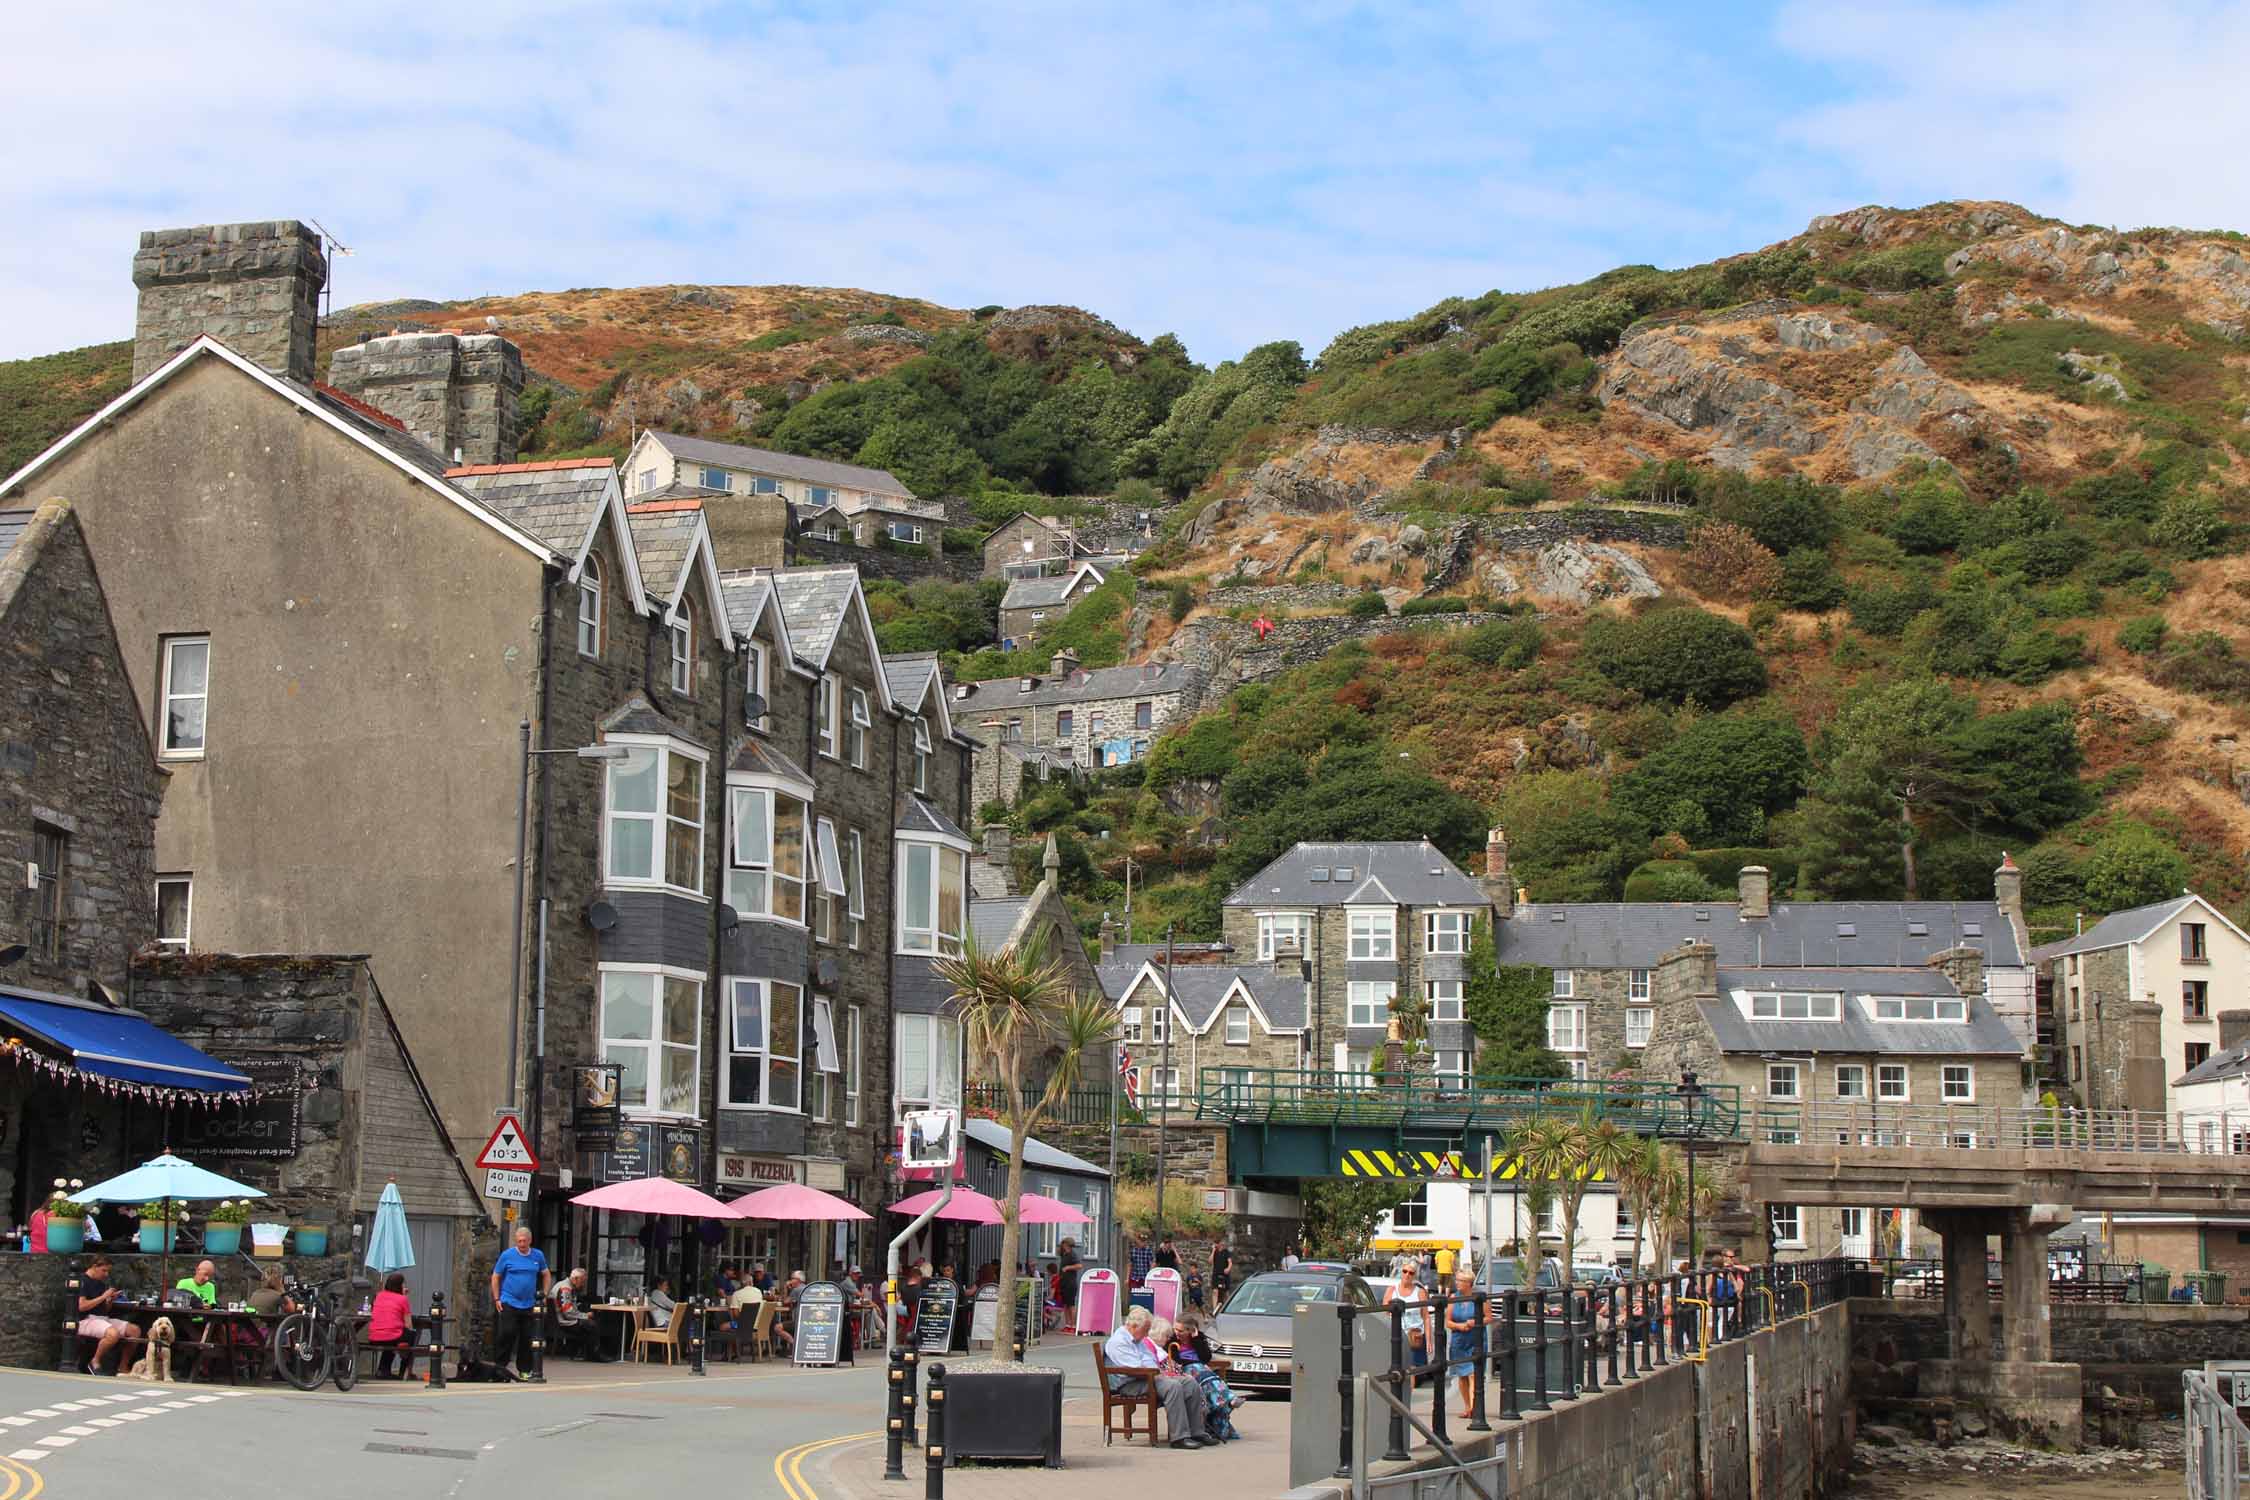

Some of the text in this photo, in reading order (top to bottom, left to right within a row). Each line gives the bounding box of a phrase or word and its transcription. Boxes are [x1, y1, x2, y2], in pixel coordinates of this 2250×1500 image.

[490, 1172, 528, 1184] 40 llath
[490, 1185, 524, 1197] 40 yds
